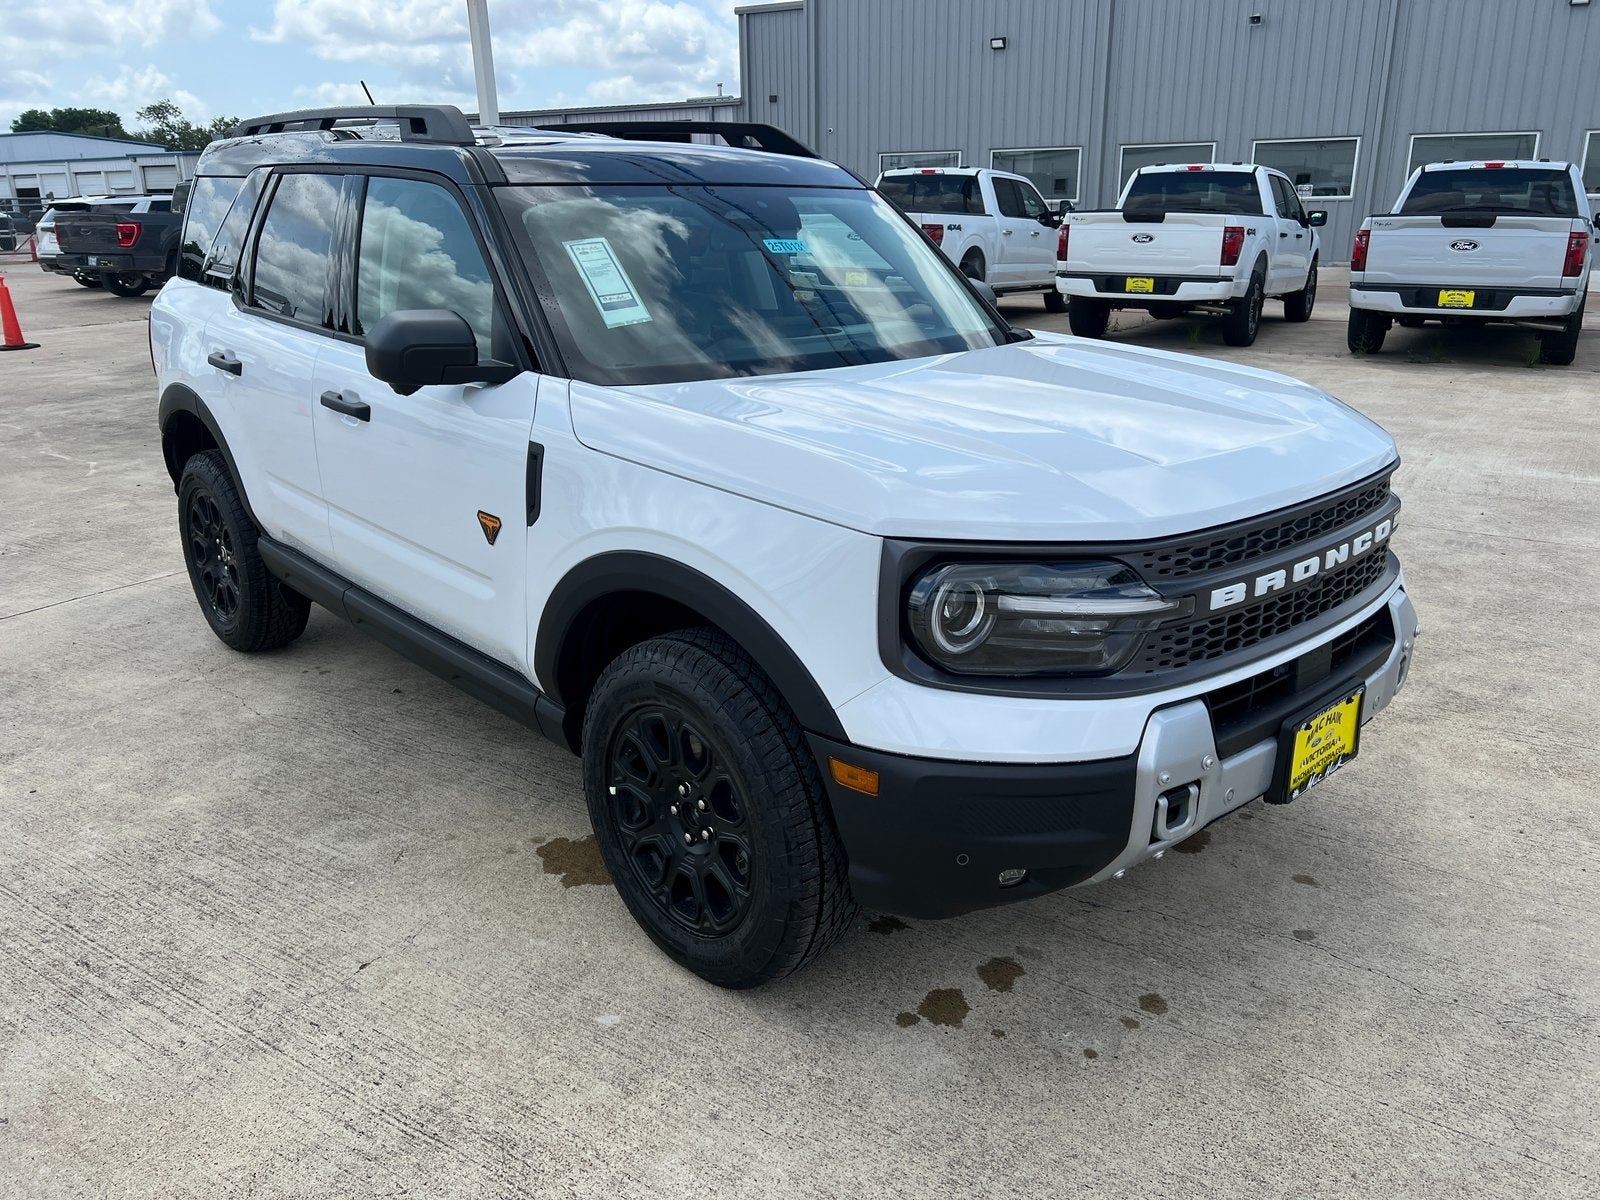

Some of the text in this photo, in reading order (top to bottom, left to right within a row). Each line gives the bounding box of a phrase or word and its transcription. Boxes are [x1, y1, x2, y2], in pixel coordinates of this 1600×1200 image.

[1454, 241, 1475, 250] Ford
[1210, 519, 1391, 611] BRONCO
[1306, 716, 1325, 748] MAC
[1325, 711, 1343, 726] HAIK
